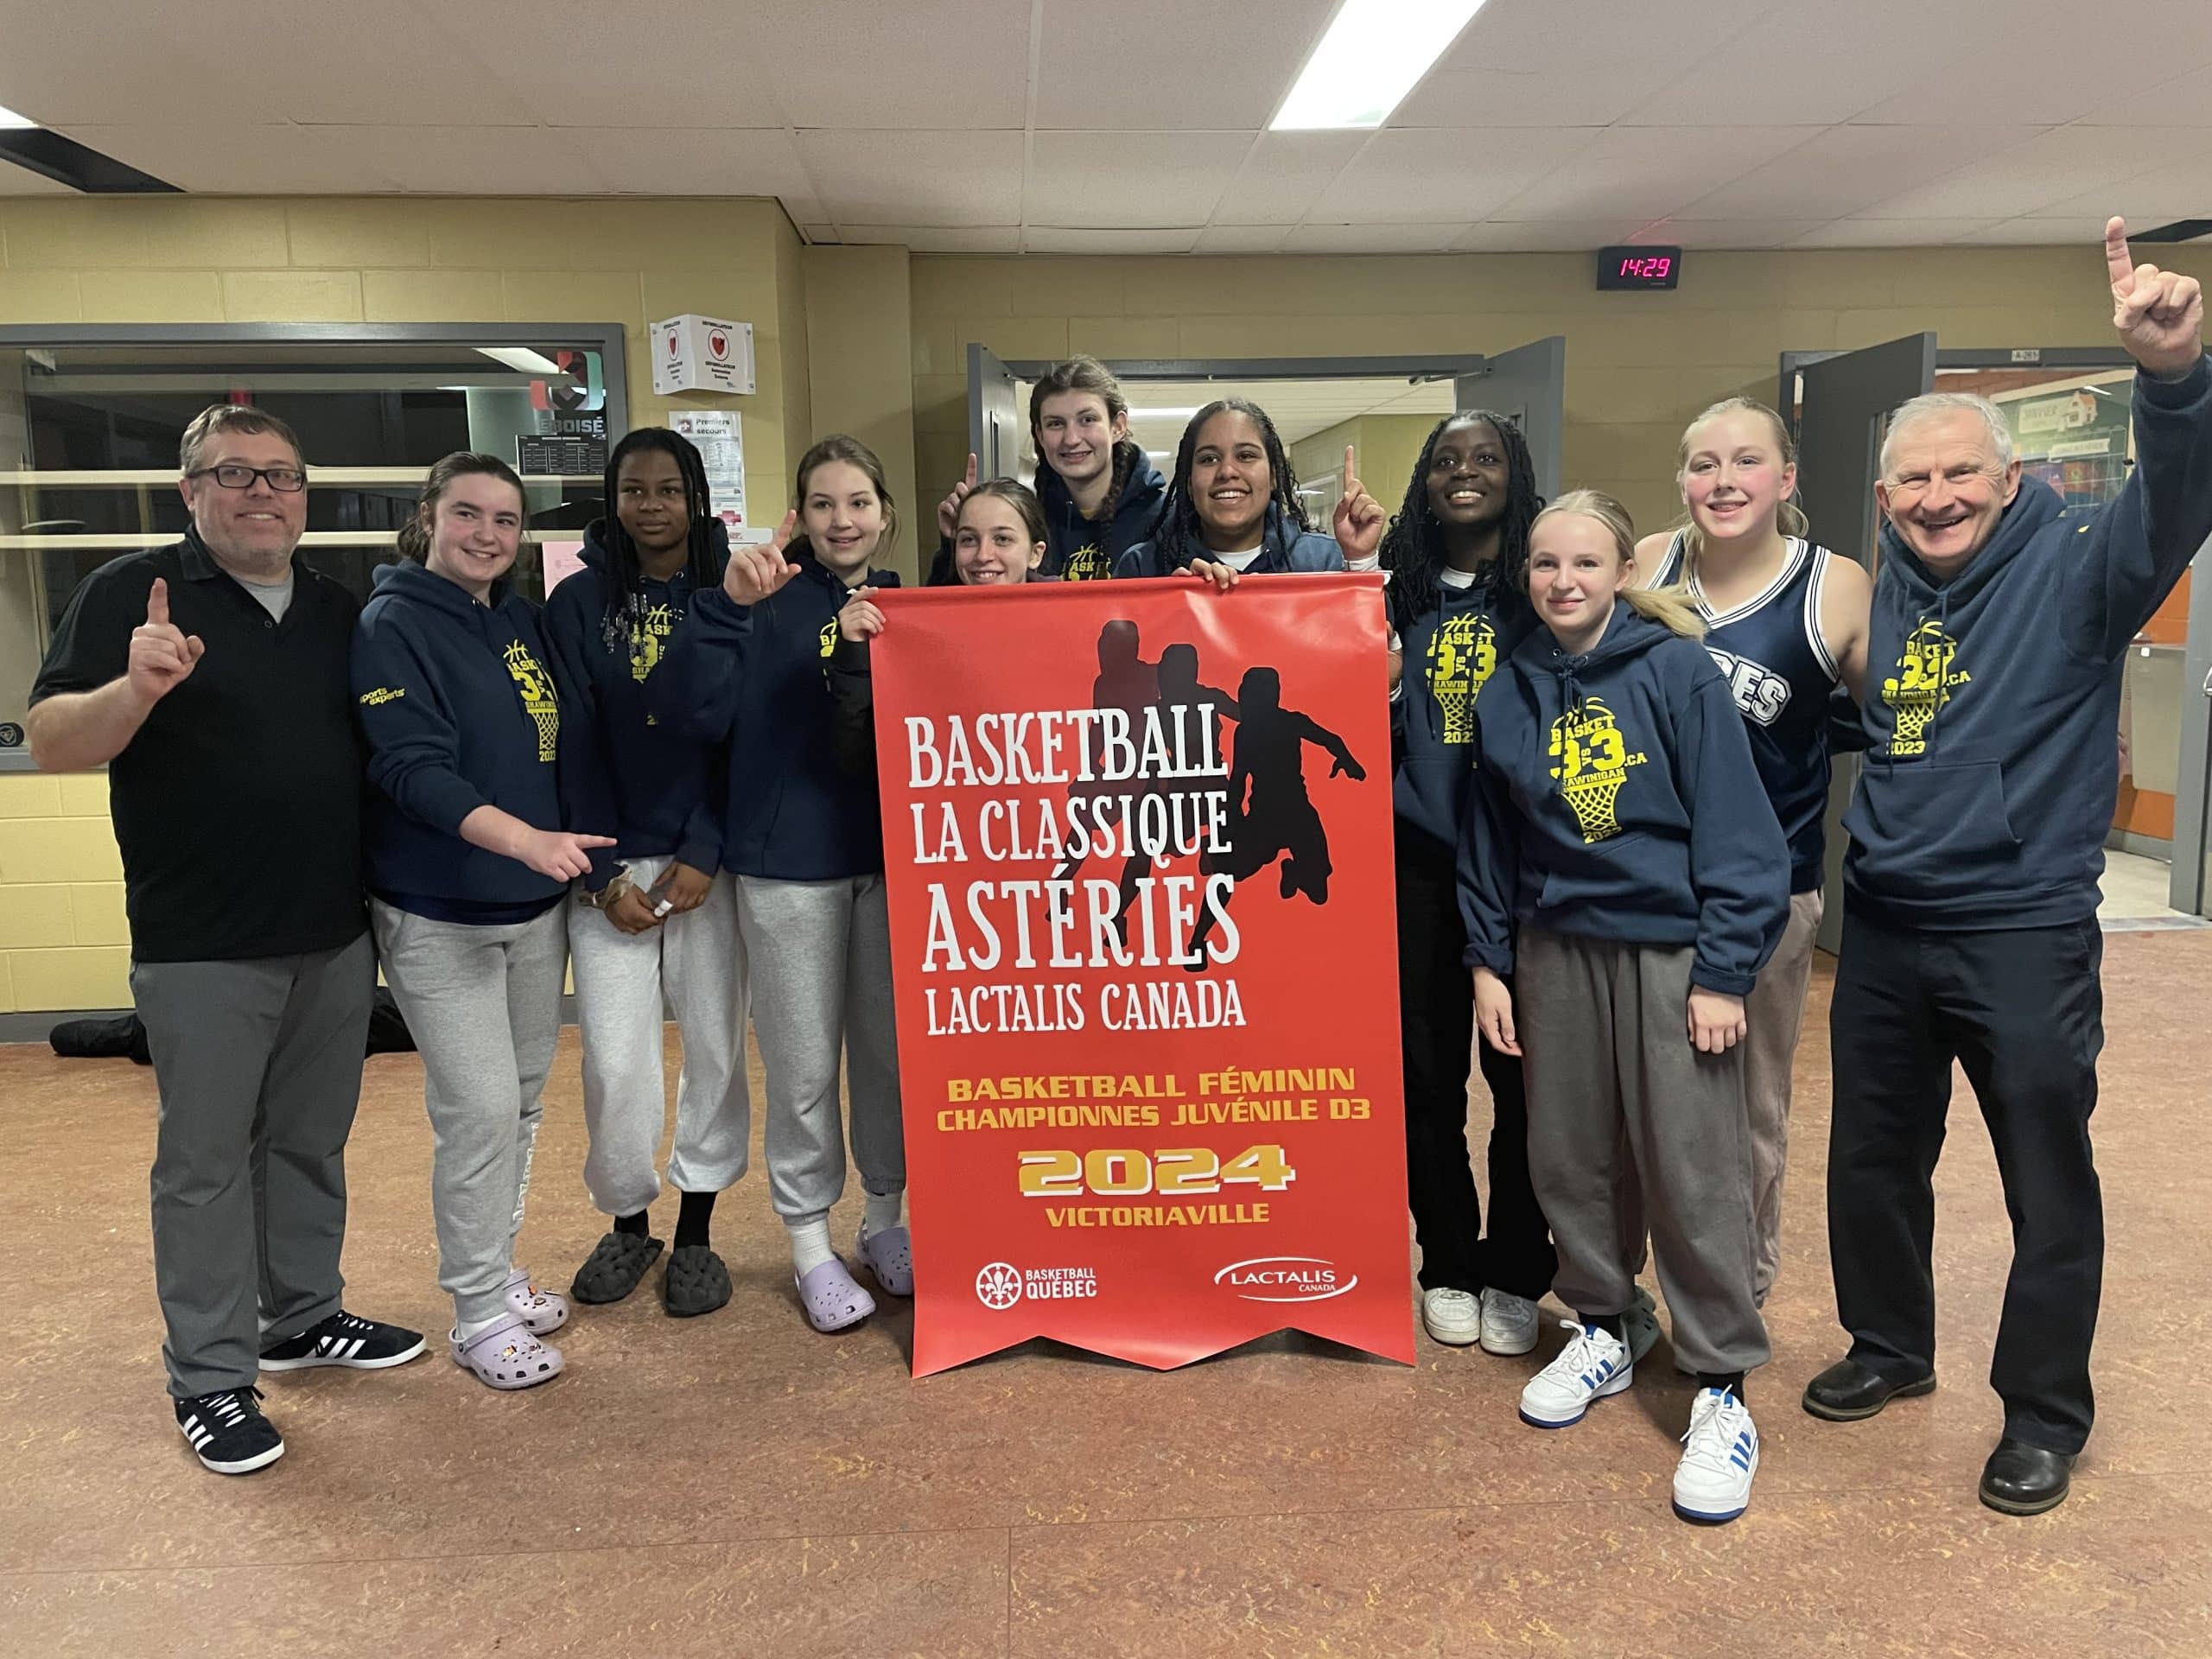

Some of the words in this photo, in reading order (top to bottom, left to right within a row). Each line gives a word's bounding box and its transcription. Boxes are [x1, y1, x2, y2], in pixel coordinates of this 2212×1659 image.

[1620, 258, 1671, 277] 14:29
[512, 671, 541, 702] 3
[904, 702, 1229, 788] BASKETBALL
[1550, 715, 1616, 742] BASKET
[1589, 728, 1626, 772] 3
[1624, 752, 1649, 767] .CA
[910, 801, 969, 864] LA
[979, 791, 1233, 869] CLASSIQUE
[921, 863, 1241, 973] ASTÉRIES
[925, 982, 1085, 1036] LACTALIS
[1100, 978, 1247, 1032] CANADA
[947, 1074, 1186, 1103] BASKETBALL
[1198, 1065, 1356, 1096] FÉMININ
[937, 1105, 1160, 1132] CHAMPIONNES
[1170, 1096, 1319, 1126] JUVÉNILE
[1329, 1098, 1370, 1121] D3
[1017, 1144, 1296, 1198] 2024
[1045, 1203, 1270, 1228] VICTORIAVILLE
[1025, 1268, 1096, 1281] BASKETBALL
[1026, 1277, 1097, 1300] QUÉBEC
[1230, 1270, 1336, 1285] LACTALIS
[1298, 1283, 1337, 1293] CANADA
